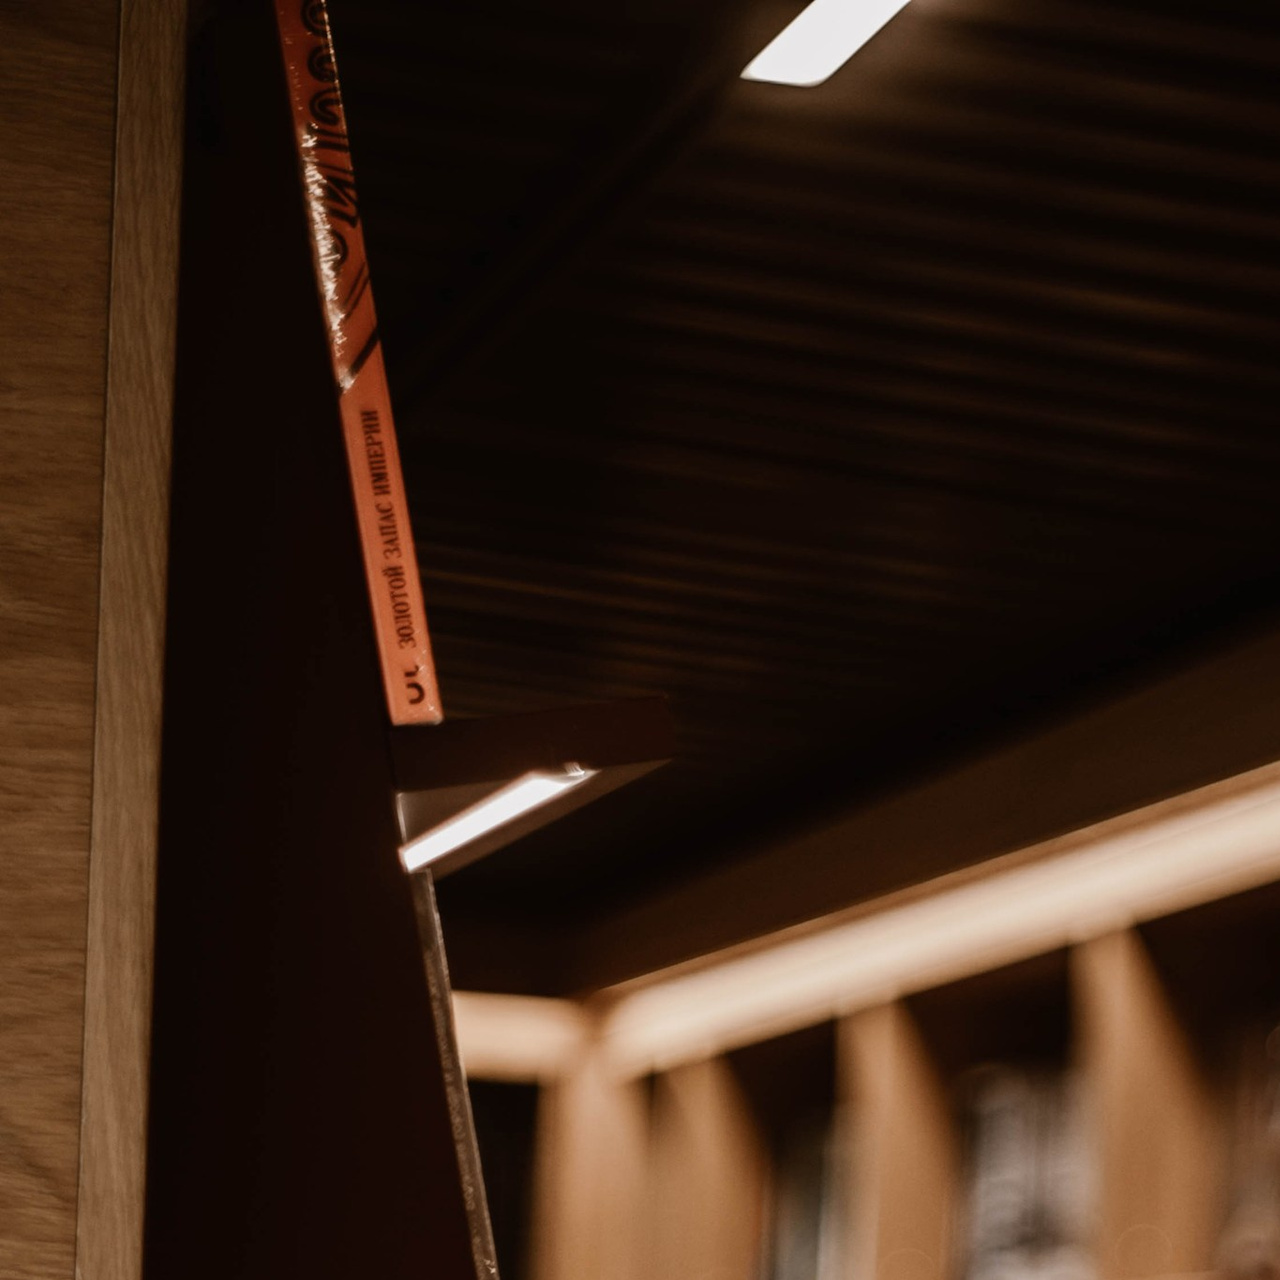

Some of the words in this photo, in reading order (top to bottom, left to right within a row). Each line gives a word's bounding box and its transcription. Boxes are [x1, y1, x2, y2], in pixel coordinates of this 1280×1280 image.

[360, 409, 391, 497] ИМПЕРИИ
[375, 501, 402, 559] ЗАПАС
[382, 565, 416, 649] ЗОЛОТОЙ
